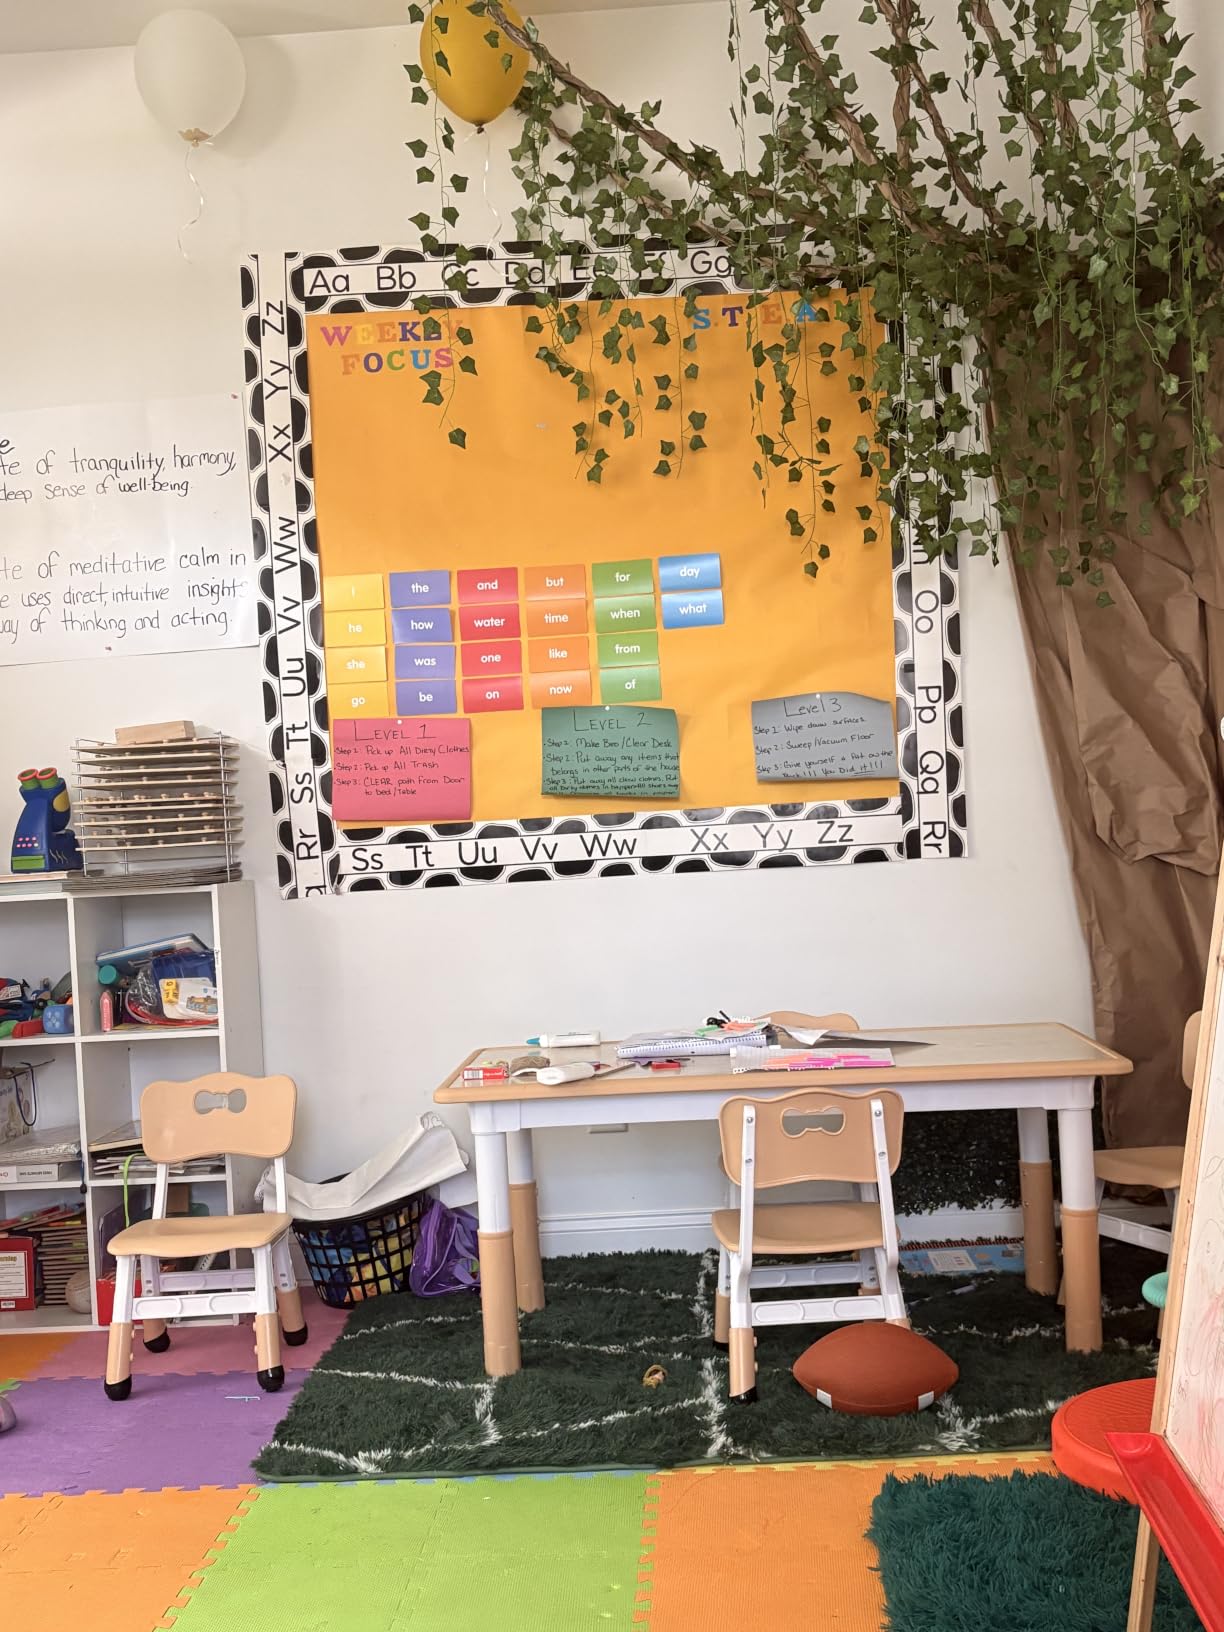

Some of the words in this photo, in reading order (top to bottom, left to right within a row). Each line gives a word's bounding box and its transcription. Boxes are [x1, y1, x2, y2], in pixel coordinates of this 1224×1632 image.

[308, 269, 350, 295] Aa
[376, 264, 417, 291] Bb
[690, 250, 732, 278] Gg
[262, 299, 285, 337] Zz
[341, 347, 454, 376] FOCUS
[264, 359, 292, 400] Yy
[268, 423, 292, 463] Xx
[36, 449, 56, 475] of
[69, 447, 167, 479] tranquility,
[173, 444, 238, 476] harmony,
[95, 474, 116, 495] of
[273, 516, 298, 574] Ww
[38, 550, 60, 579] of
[69, 551, 167, 577] meditative
[179, 546, 220, 569] calm
[229, 548, 247, 566] in
[679, 566, 700, 579] day
[411, 582, 430, 593] the
[477, 579, 498, 591] and
[546, 576, 564, 588] but
[615, 572, 631, 583] for
[21, 591, 52, 608] uses
[112, 582, 170, 602] intuitive
[278, 595, 301, 635] Vv
[544, 613, 569, 623] time
[610, 608, 641, 619] when
[679, 604, 708, 615] what
[914, 589, 940, 634] Oo
[30, 606, 52, 634] of
[61, 607, 127, 639] thinking
[134, 609, 160, 630] and
[348, 623, 362, 634] he
[410, 620, 434, 630] how
[474, 617, 506, 628] water
[481, 653, 502, 664] one
[548, 648, 568, 659] like
[615, 643, 641, 654] from
[346, 658, 366, 669] she
[414, 657, 437, 667] was
[282, 657, 306, 697] Uu
[625, 679, 637, 690] of
[418, 691, 434, 702] be
[485, 689, 500, 700] on
[549, 685, 573, 695] now
[351, 695, 366, 708] go
[783, 698, 826, 718] Level
[829, 697, 842, 713] 3
[913, 685, 942, 724] Pp
[353, 720, 411, 742] LEVEL
[417, 724, 437, 739] 1
[572, 709, 627, 732] LEVEL
[636, 712, 653, 727] 2
[286, 720, 309, 750] Tt
[384, 749, 394, 757] up
[363, 776, 393, 788] CLEAR
[916, 750, 945, 795] Qq
[290, 771, 313, 804] Ss
[296, 828, 319, 860] Rr
[352, 847, 384, 872] Ss
[405, 844, 434, 868] Tt
[458, 841, 497, 865] Uu
[520, 837, 558, 861] Vv
[579, 832, 637, 857] Ww
[690, 827, 730, 853] Xx
[752, 823, 793, 852] Yy
[816, 820, 854, 844] Zz
[922, 820, 947, 854] Rr
